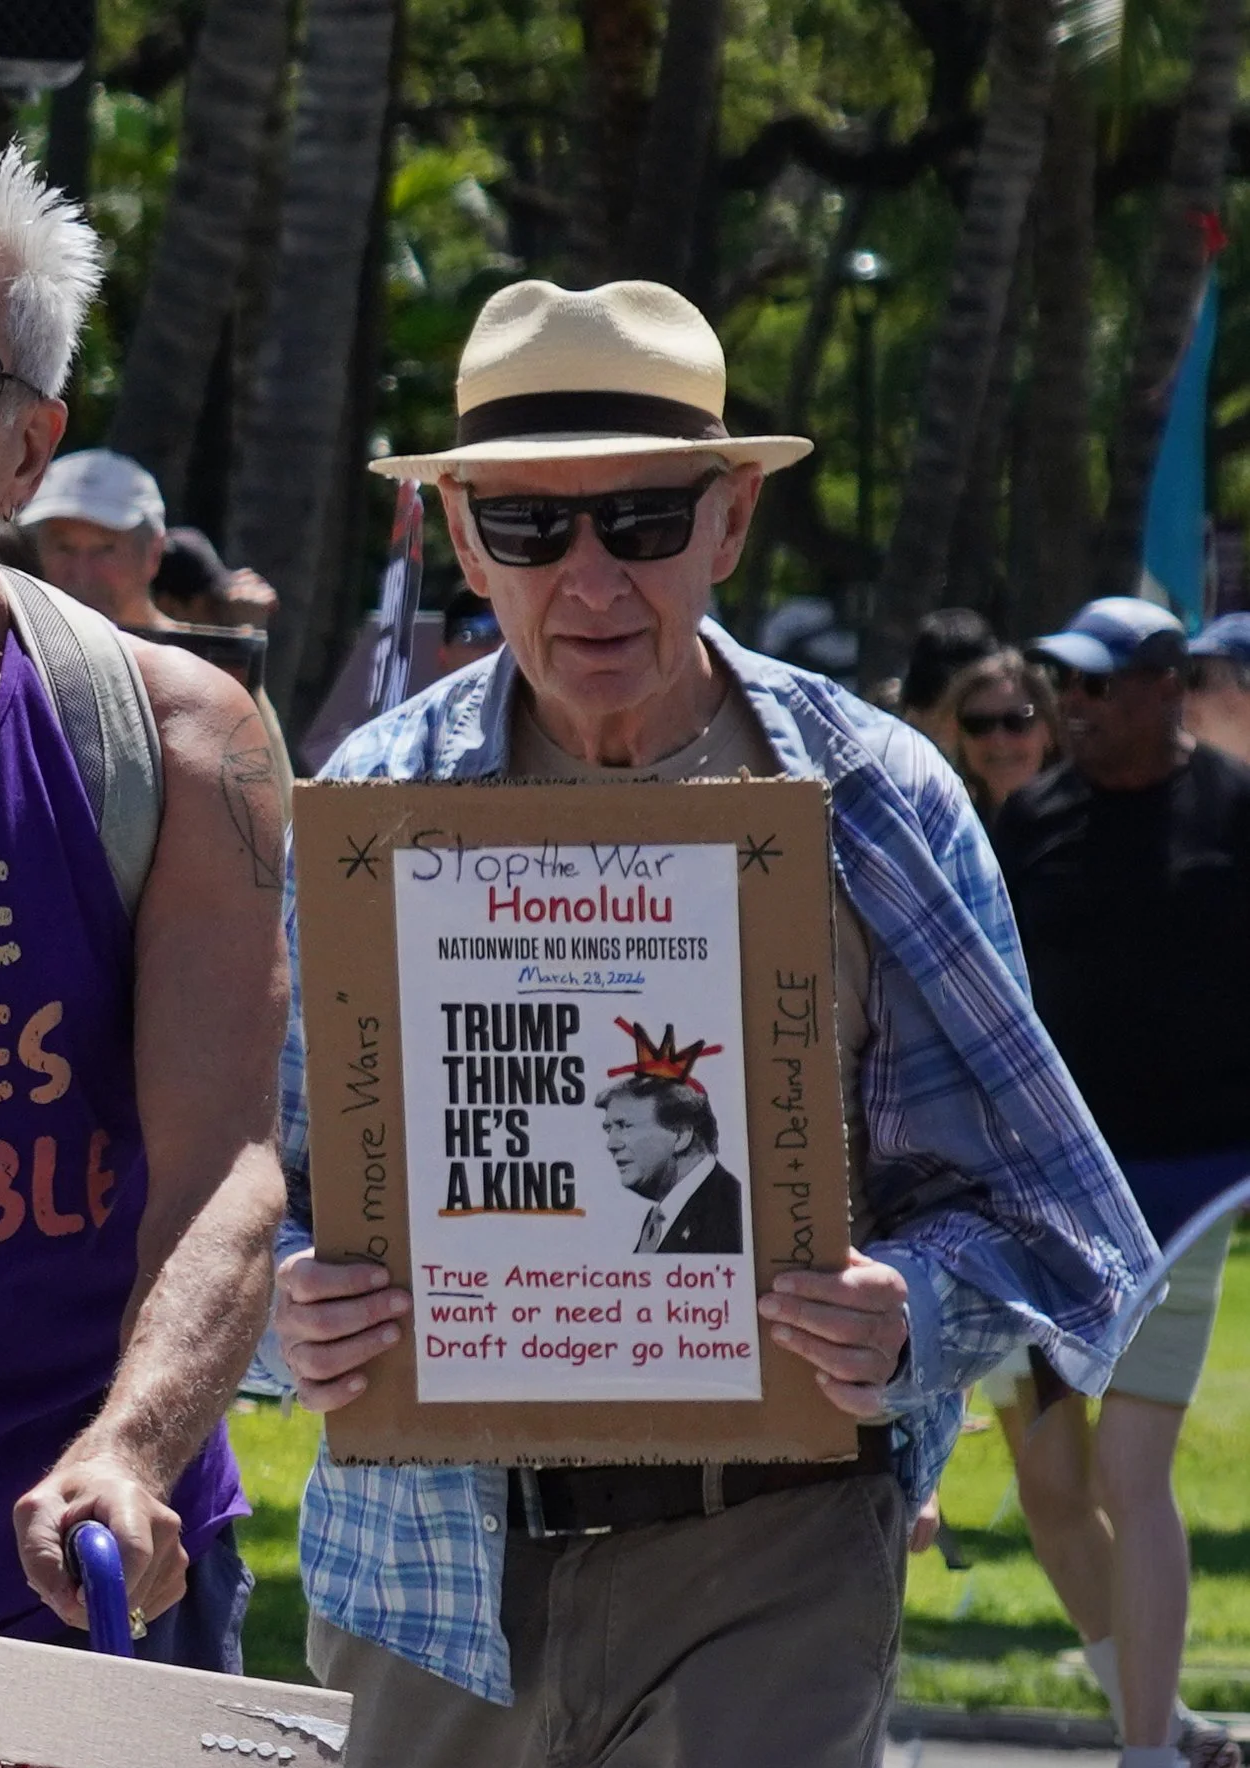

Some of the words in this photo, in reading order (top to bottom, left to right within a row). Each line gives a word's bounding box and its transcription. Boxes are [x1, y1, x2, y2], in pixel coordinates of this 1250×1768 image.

[412, 829, 530, 888] Stop
[534, 839, 581, 880] the
[590, 840, 675, 881] War
[489, 884, 673, 923] Honolulu
[437, 936, 540, 961] NATIONWIDE
[544, 936, 569, 960] NO
[571, 936, 621, 960] KINGS
[625, 936, 709, 960] PROTESTS
[517, 965, 580, 985] March
[440, 1003, 581, 1052] TRUMP
[772, 969, 811, 1048] ICE
[442, 1055, 586, 1106] THINKS
[771, 1057, 808, 1150] Defund
[444, 1108, 530, 1158] HE'S
[361, 1122, 387, 1222] more
[445, 1162, 472, 1211] A
[482, 1161, 576, 1211] KING
[769, 1181, 814, 1270] band
[422, 1264, 489, 1288] True
[504, 1264, 651, 1289] Americans
[666, 1264, 736, 1289] don't
[431, 1301, 497, 1324] want
[511, 1306, 541, 1324] or
[555, 1300, 622, 1324] need
[636, 1306, 653, 1324] a
[666, 1299, 730, 1331] king!
[426, 1334, 507, 1359] Draft
[521, 1335, 618, 1366] dodger
[632, 1341, 664, 1367] go
[677, 1335, 752, 1360] home
